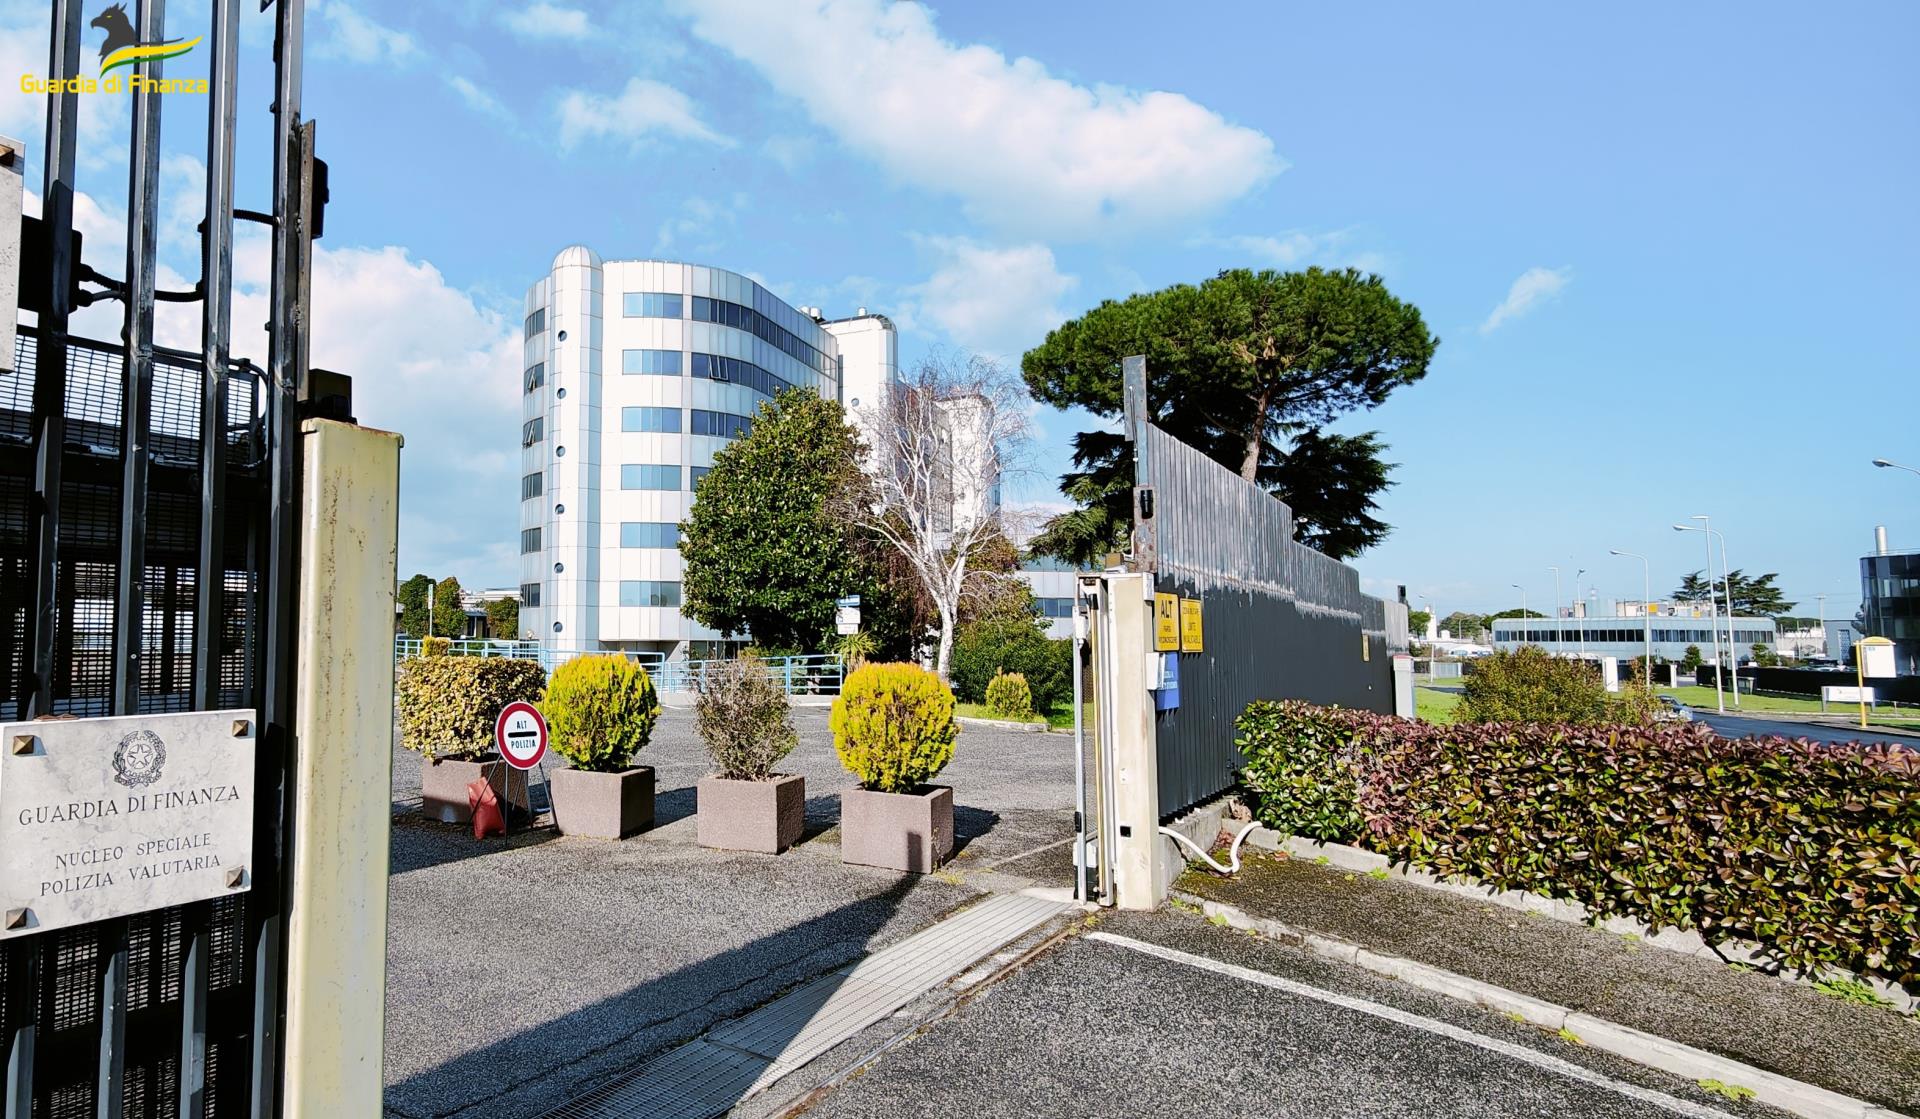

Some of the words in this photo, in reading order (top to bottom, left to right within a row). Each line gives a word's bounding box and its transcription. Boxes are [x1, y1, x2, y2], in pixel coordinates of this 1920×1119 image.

[1160, 599, 1173, 619] ALT
[516, 720, 528, 730] ALT
[511, 739, 536, 750] POLIZIA
[19, 799, 118, 826] GUARDIA
[127, 796, 146, 814] DI
[153, 785, 240, 810] FINANZA
[55, 846, 124, 870] NUCLEO
[136, 832, 211, 857] SPECIALE
[40, 872, 114, 897] POLIZIA
[128, 854, 221, 881] VALUTARIA
